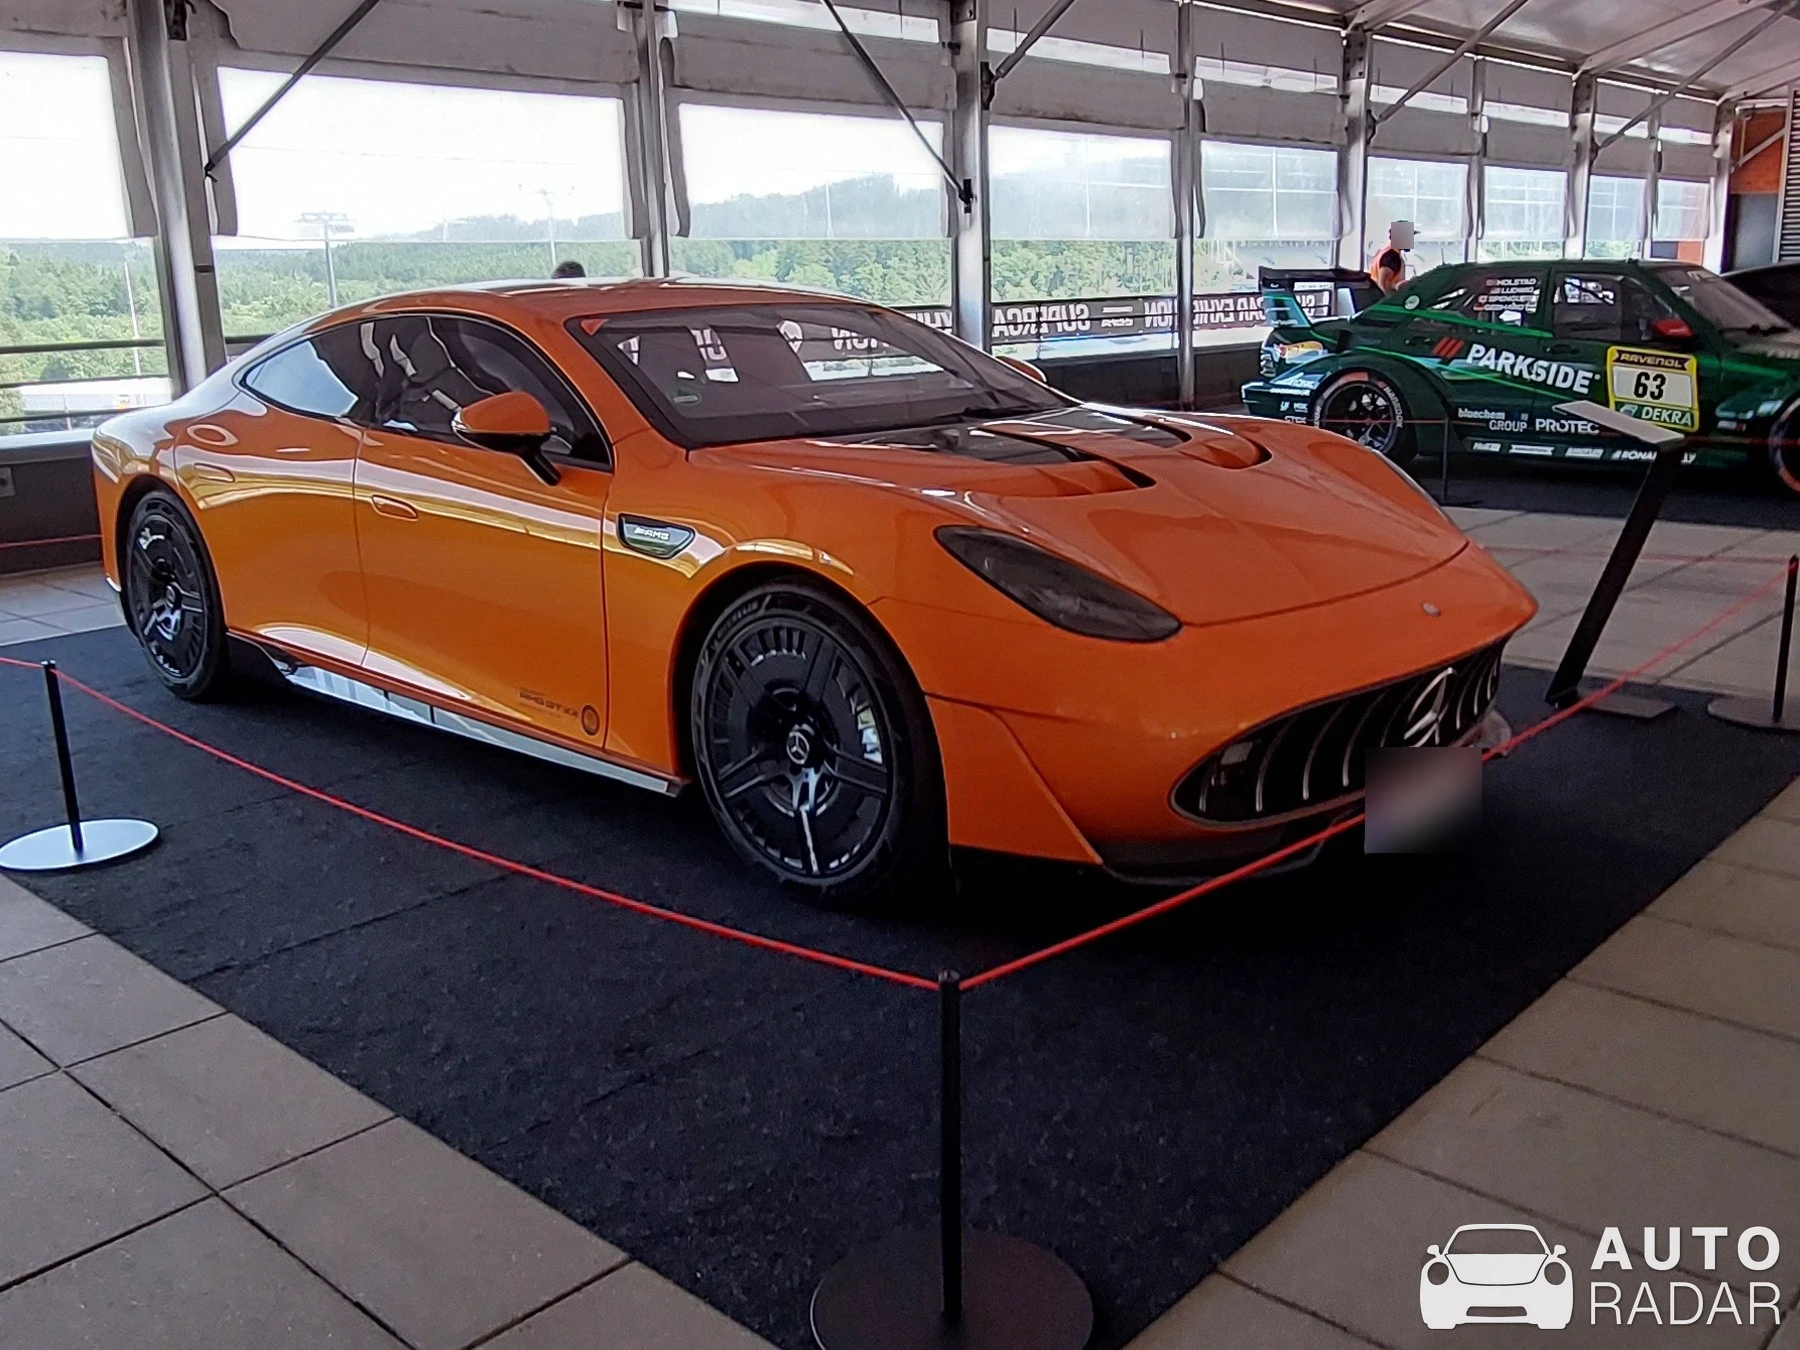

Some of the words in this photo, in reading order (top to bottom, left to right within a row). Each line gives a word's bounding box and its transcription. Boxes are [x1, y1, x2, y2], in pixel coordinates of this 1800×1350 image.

[1466, 343, 1594, 394] PARKSIDE
[1620, 353, 1682, 368] RAVENOL
[1633, 371, 1667, 401] 63
[1641, 406, 1691, 427] DEKRA
[1489, 419, 1528, 433] GROUP
[1535, 418, 1600, 434] PROTEC
